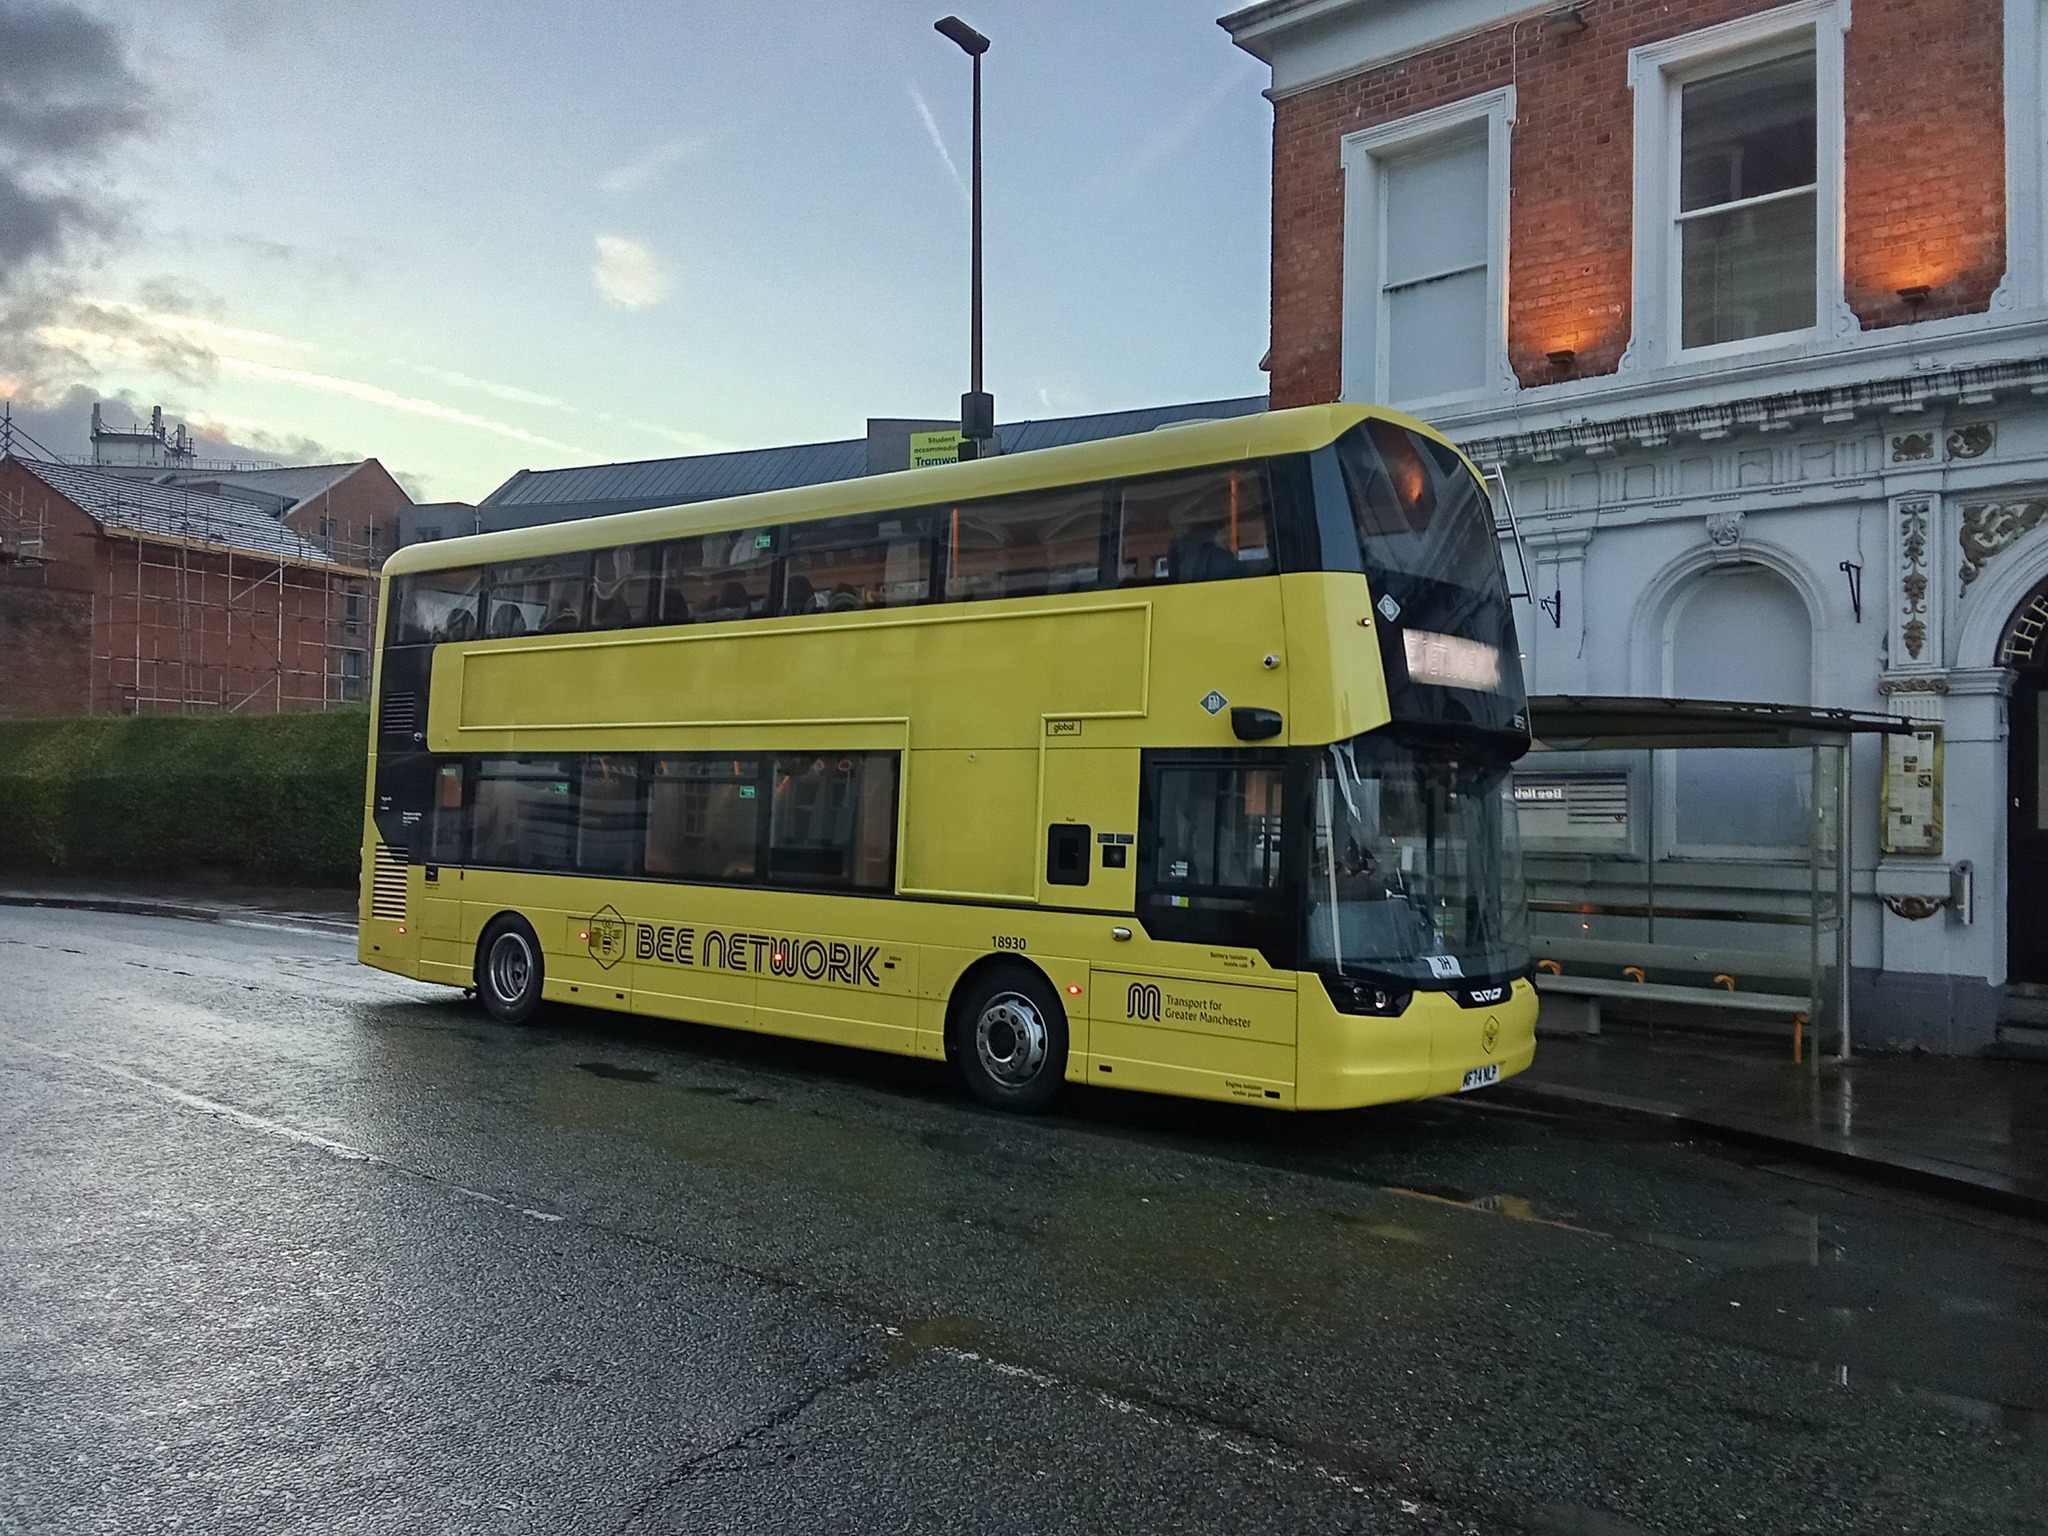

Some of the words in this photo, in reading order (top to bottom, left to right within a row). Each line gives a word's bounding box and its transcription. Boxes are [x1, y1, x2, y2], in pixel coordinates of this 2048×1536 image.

[928, 436, 956, 444] Student
[915, 456, 957, 467] Tramwa
[1054, 722, 1075, 734] global
[991, 935, 1026, 950] 18930
[636, 924, 694, 965] BEE
[703, 930, 880, 987] NETWORK
[1166, 994, 1208, 1010] Transport
[1209, 1000, 1222, 1011] for
[1165, 1007, 1197, 1021] Greater
[1200, 1012, 1251, 1028] Manchester
[1483, 1065, 1497, 1082] NLP
